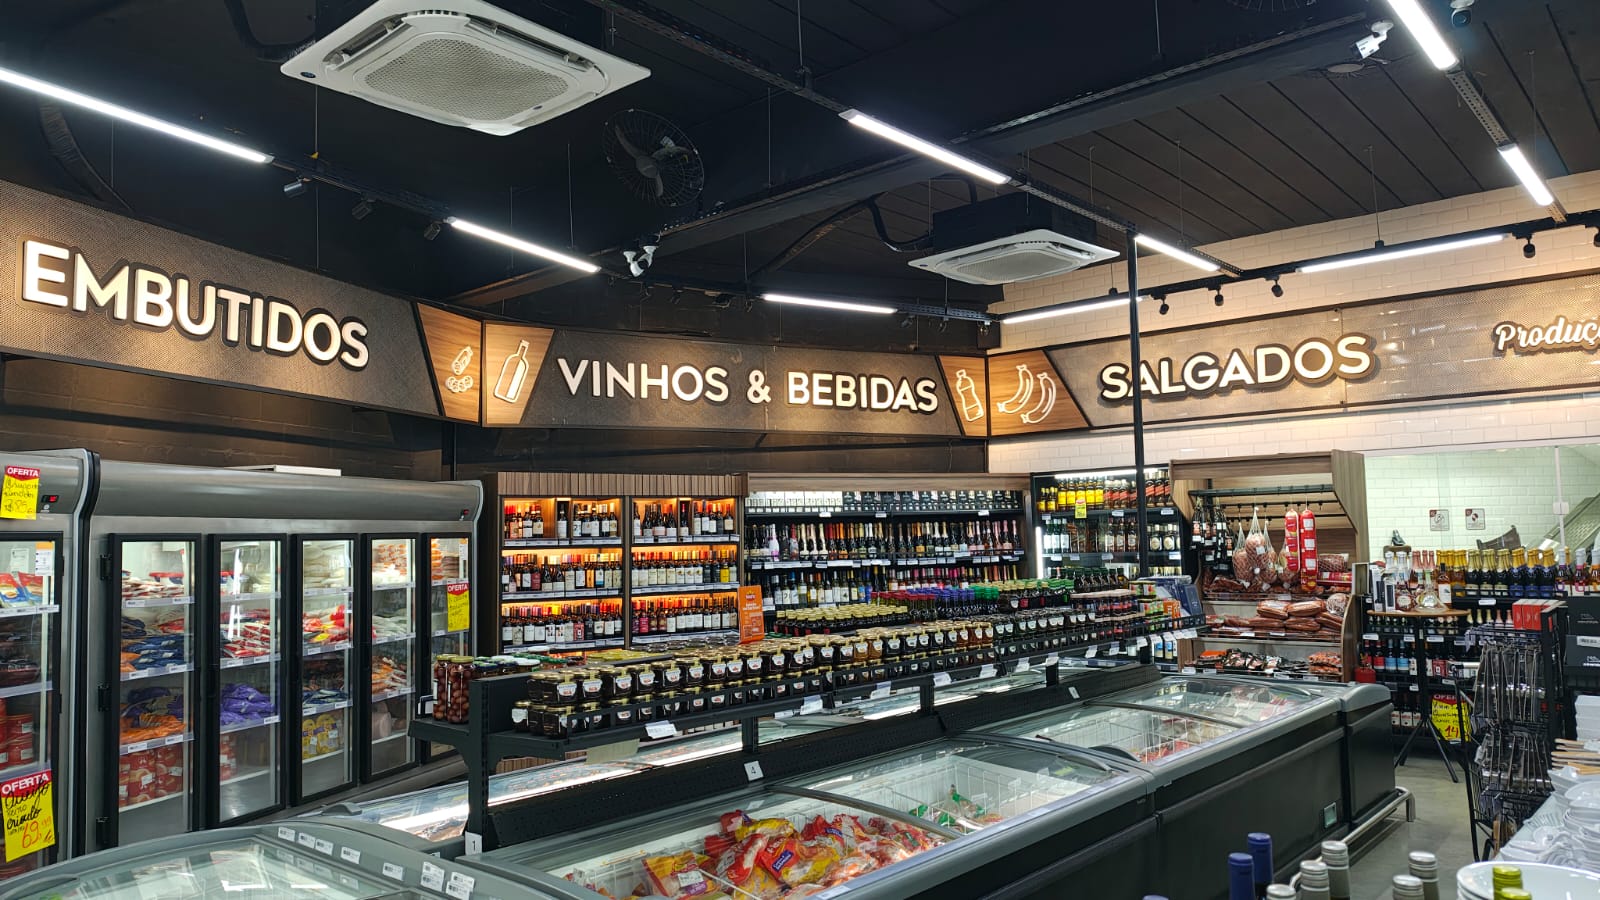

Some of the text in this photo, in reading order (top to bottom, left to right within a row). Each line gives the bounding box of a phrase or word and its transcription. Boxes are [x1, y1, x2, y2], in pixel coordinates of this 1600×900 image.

[22, 239, 370, 368] EMBUTIDOS
[1495, 316, 1600, 351] Produç
[1100, 335, 1371, 399] SALGADOS
[558, 358, 938, 412] VINHOS & BEBIDAS
[7, 467, 39, 477] OFERTA
[448, 584, 468, 592] OFERTA
[1, 773, 50, 795] OFERTA
